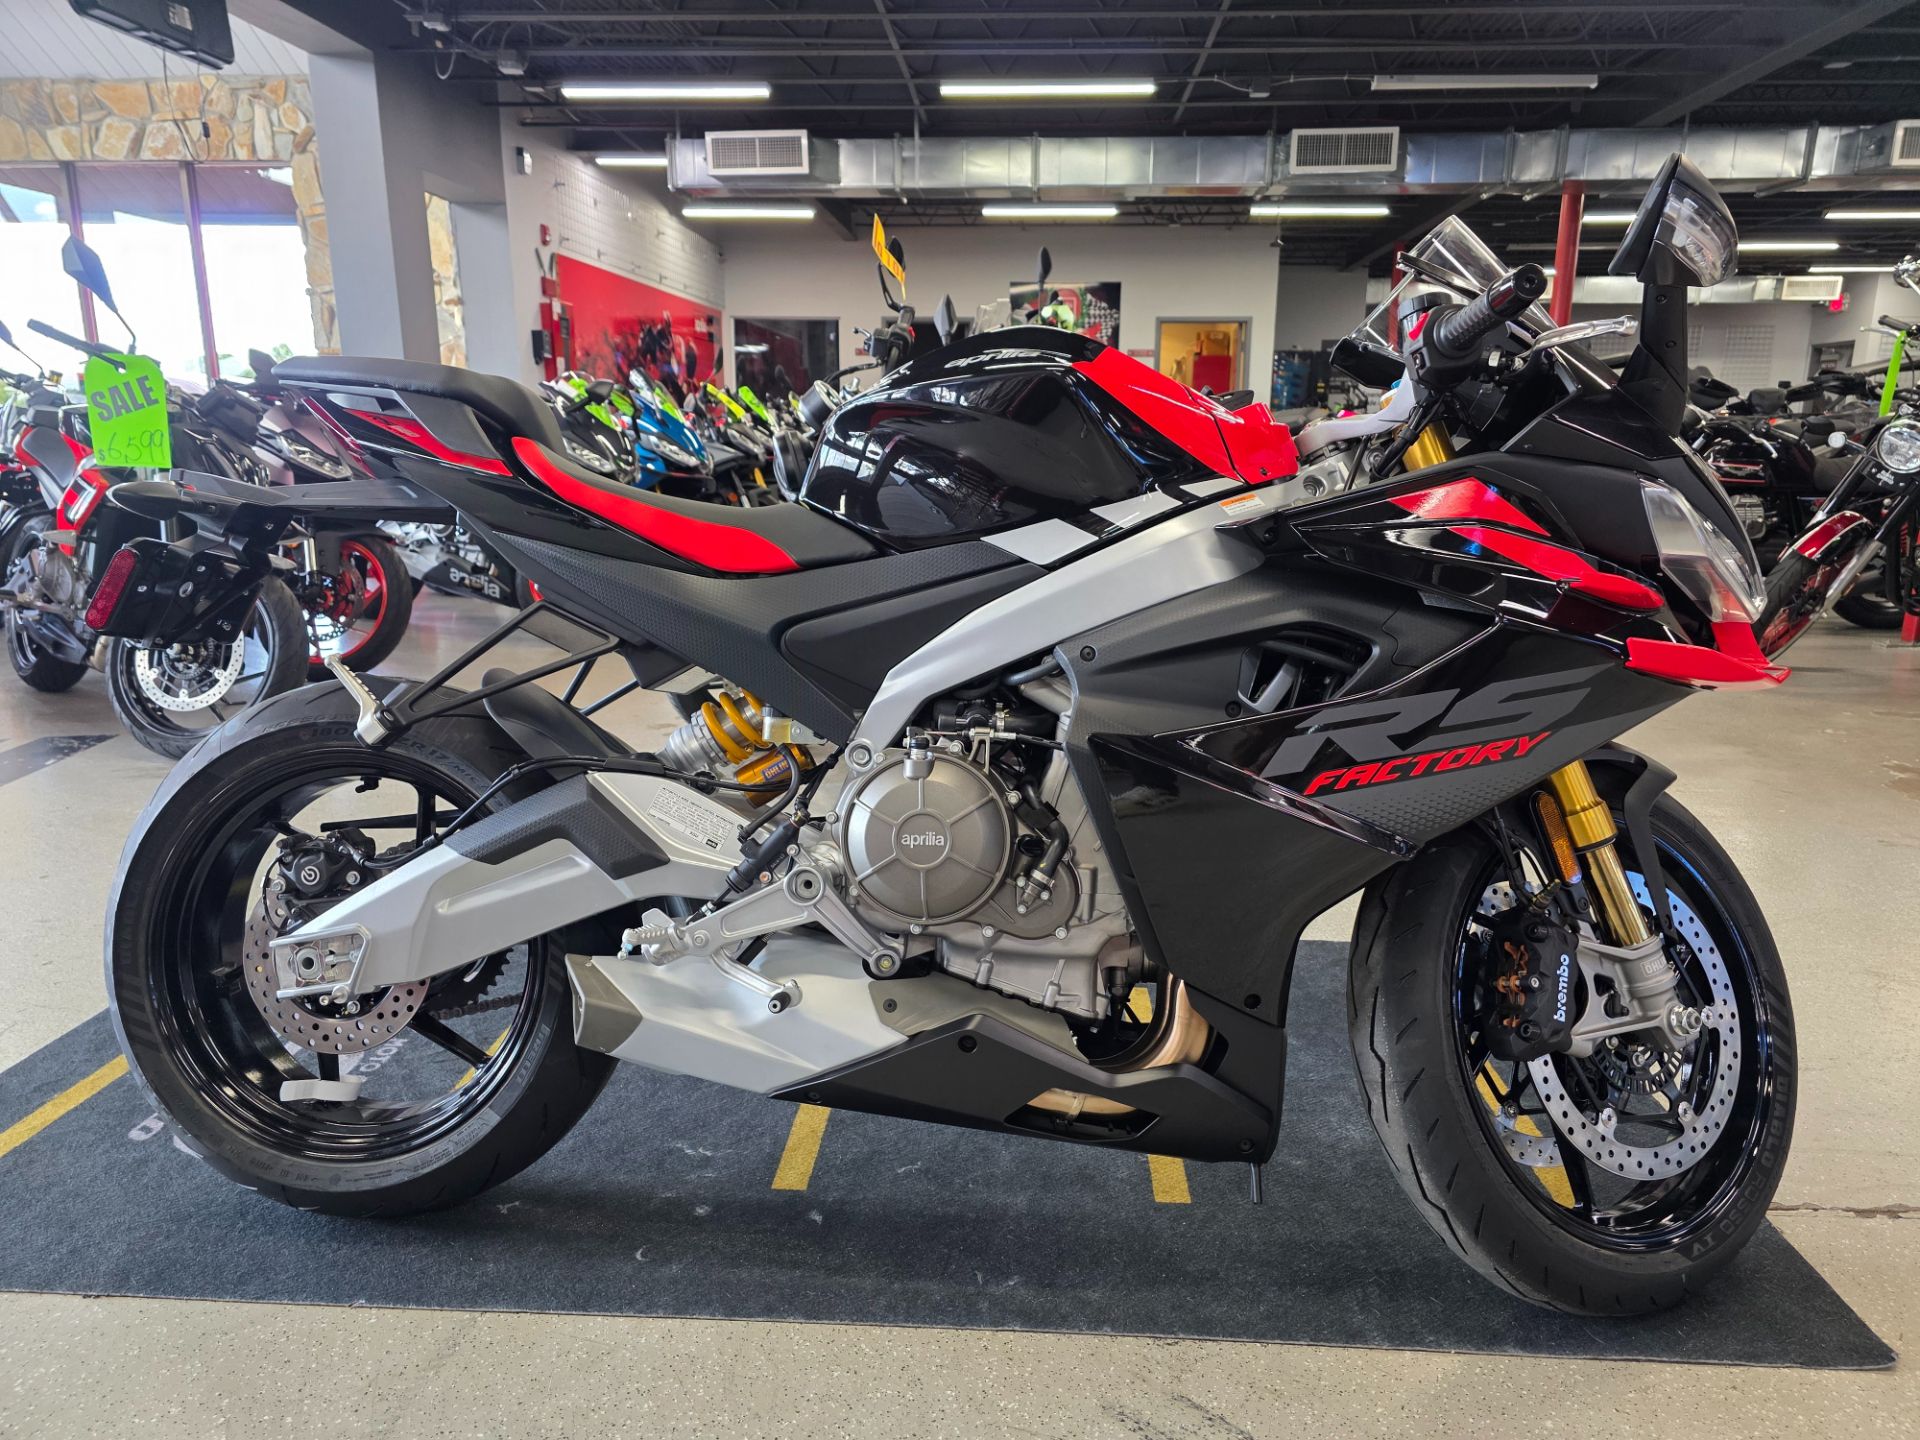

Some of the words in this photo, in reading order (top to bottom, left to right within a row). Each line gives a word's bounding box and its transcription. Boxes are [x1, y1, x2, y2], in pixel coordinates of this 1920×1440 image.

[91, 375, 160, 423] SALE
[449, 567, 501, 599] ailia
[1260, 664, 1608, 778] RS
[1303, 731, 1552, 796] FACTORY
[901, 831, 945, 849] aprilia
[1553, 953, 1570, 1023] brembo
[1761, 1079, 1790, 1168] DIABLO
[1719, 1172, 1769, 1236] ROSSO
